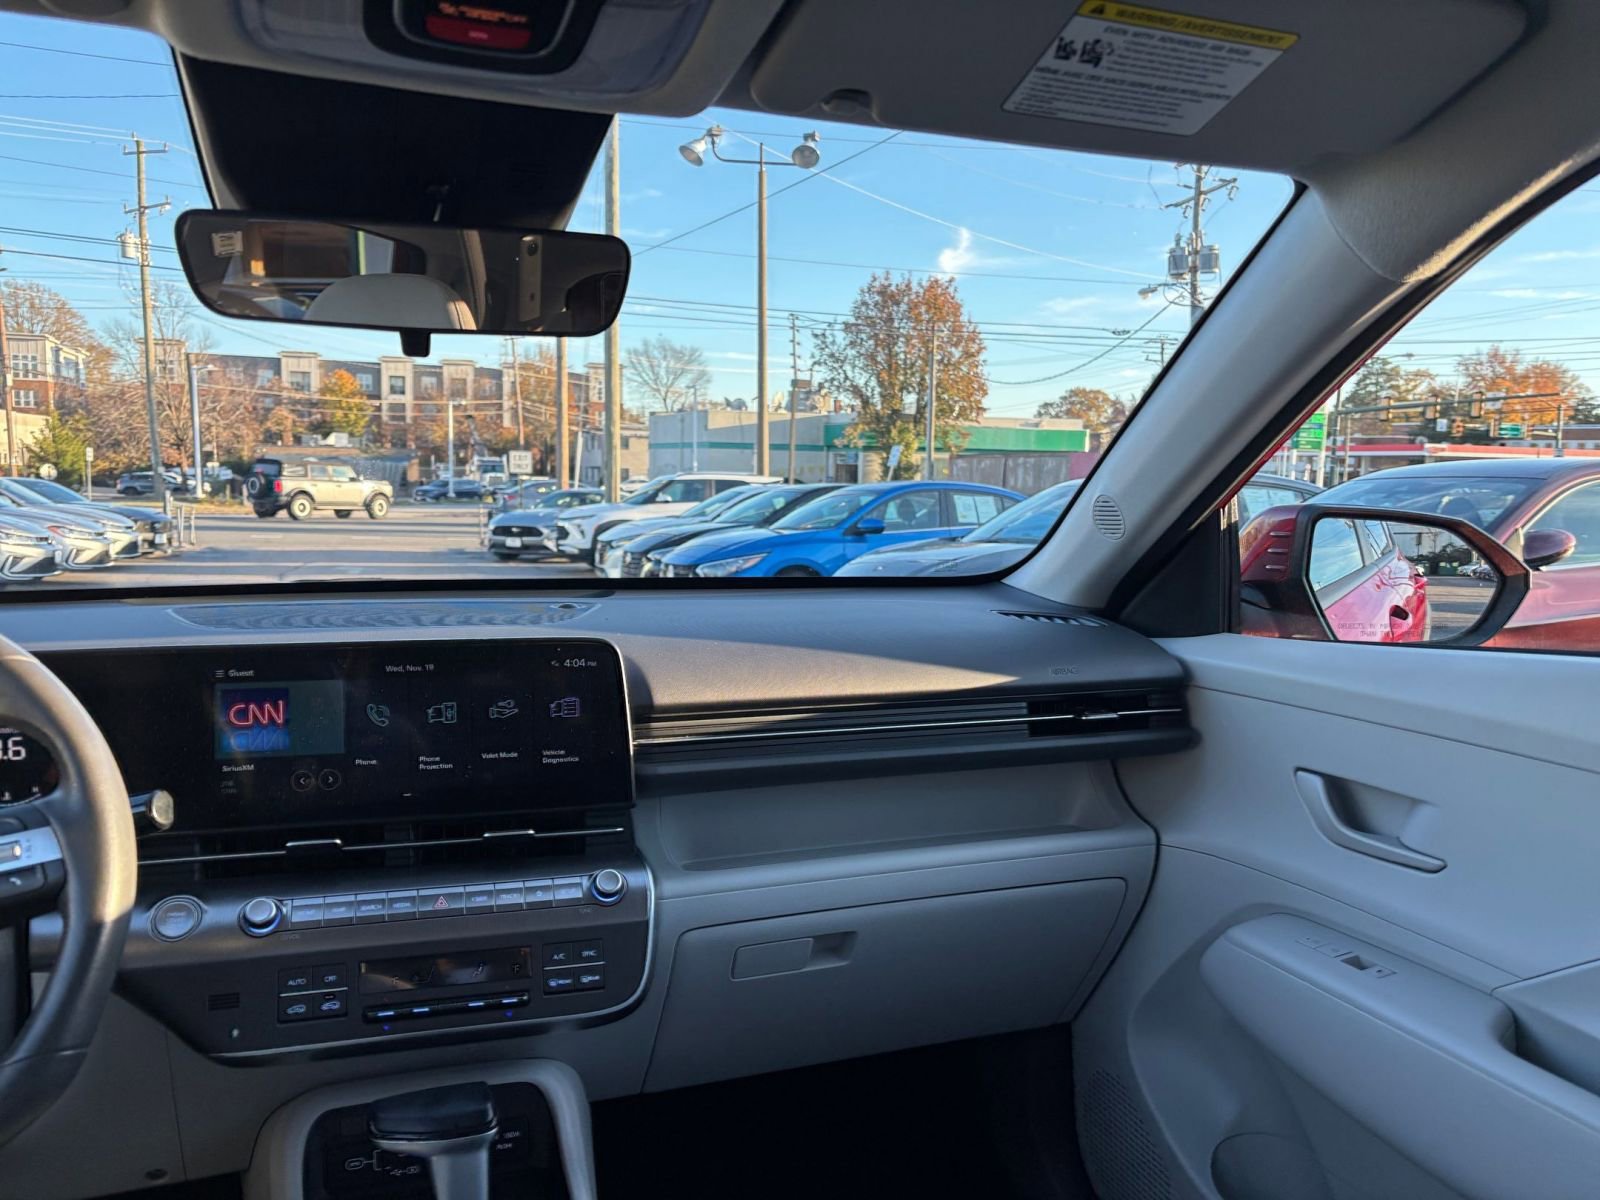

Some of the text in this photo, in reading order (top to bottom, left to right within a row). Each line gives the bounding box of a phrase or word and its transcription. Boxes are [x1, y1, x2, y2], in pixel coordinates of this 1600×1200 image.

[563, 658, 585, 667] 4:04
[228, 700, 285, 726] CNN
[222, 764, 255, 772] SiriusXM
